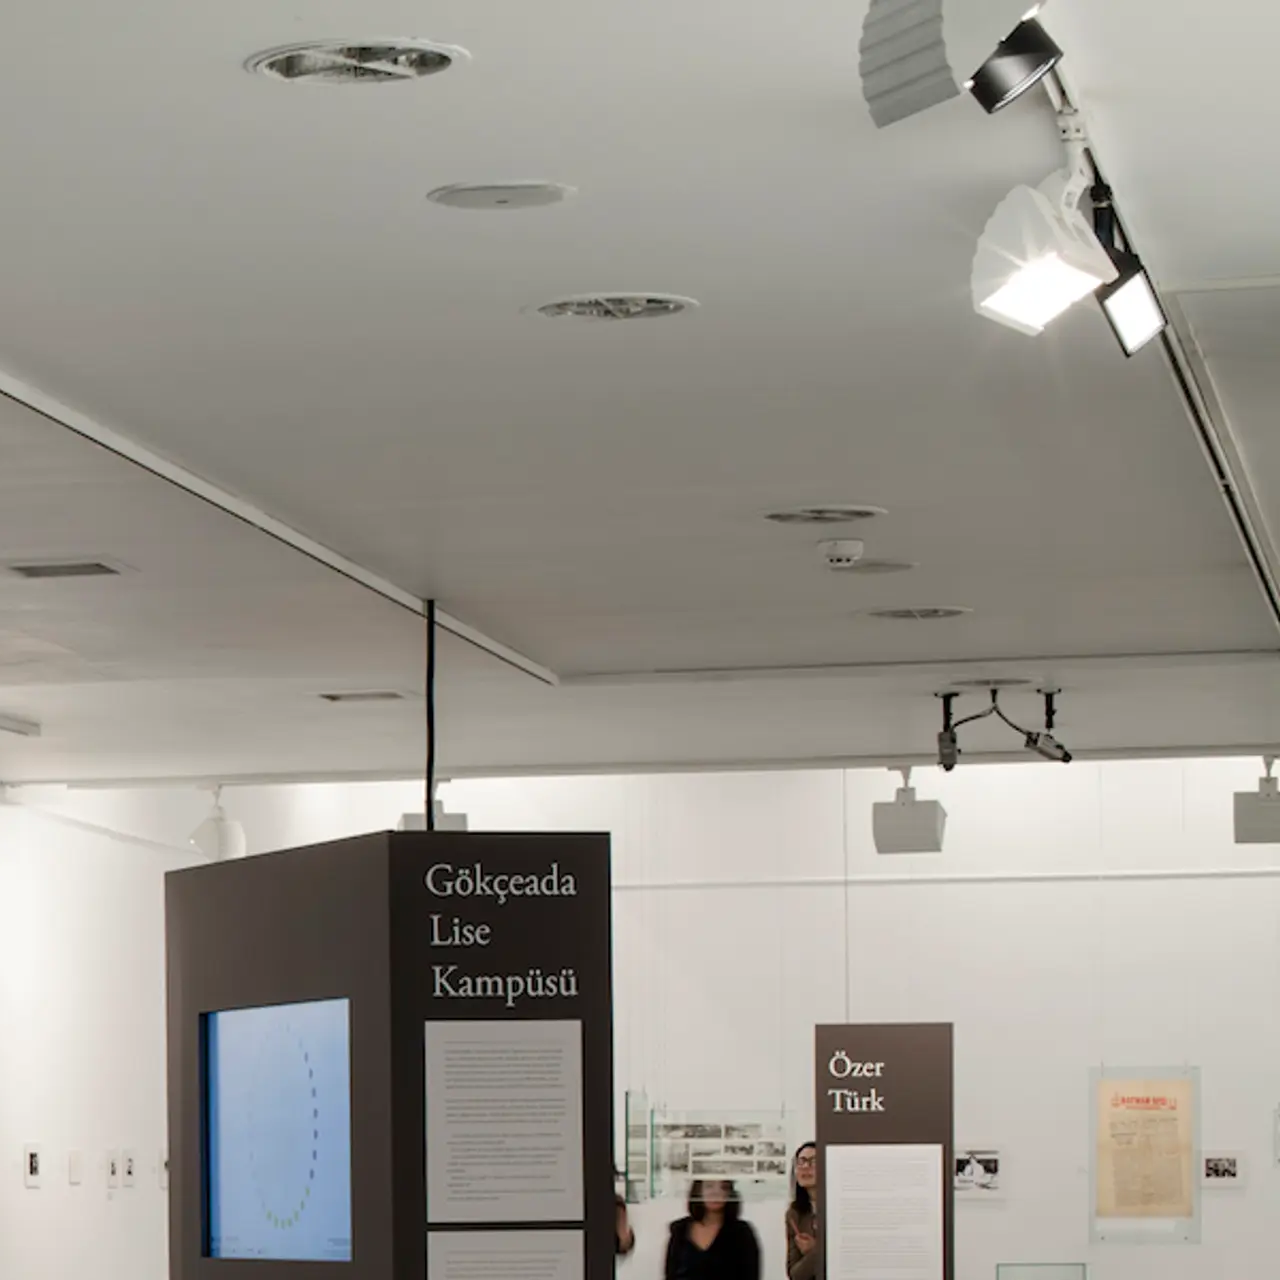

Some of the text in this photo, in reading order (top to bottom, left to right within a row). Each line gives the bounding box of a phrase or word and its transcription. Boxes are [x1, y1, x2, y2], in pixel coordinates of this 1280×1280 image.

[425, 862, 577, 904] Gökçeada
[430, 914, 492, 946] Lise
[432, 965, 578, 1007] Kampüsü
[828, 1050, 885, 1078] Özer
[827, 1088, 885, 1112] Türk
